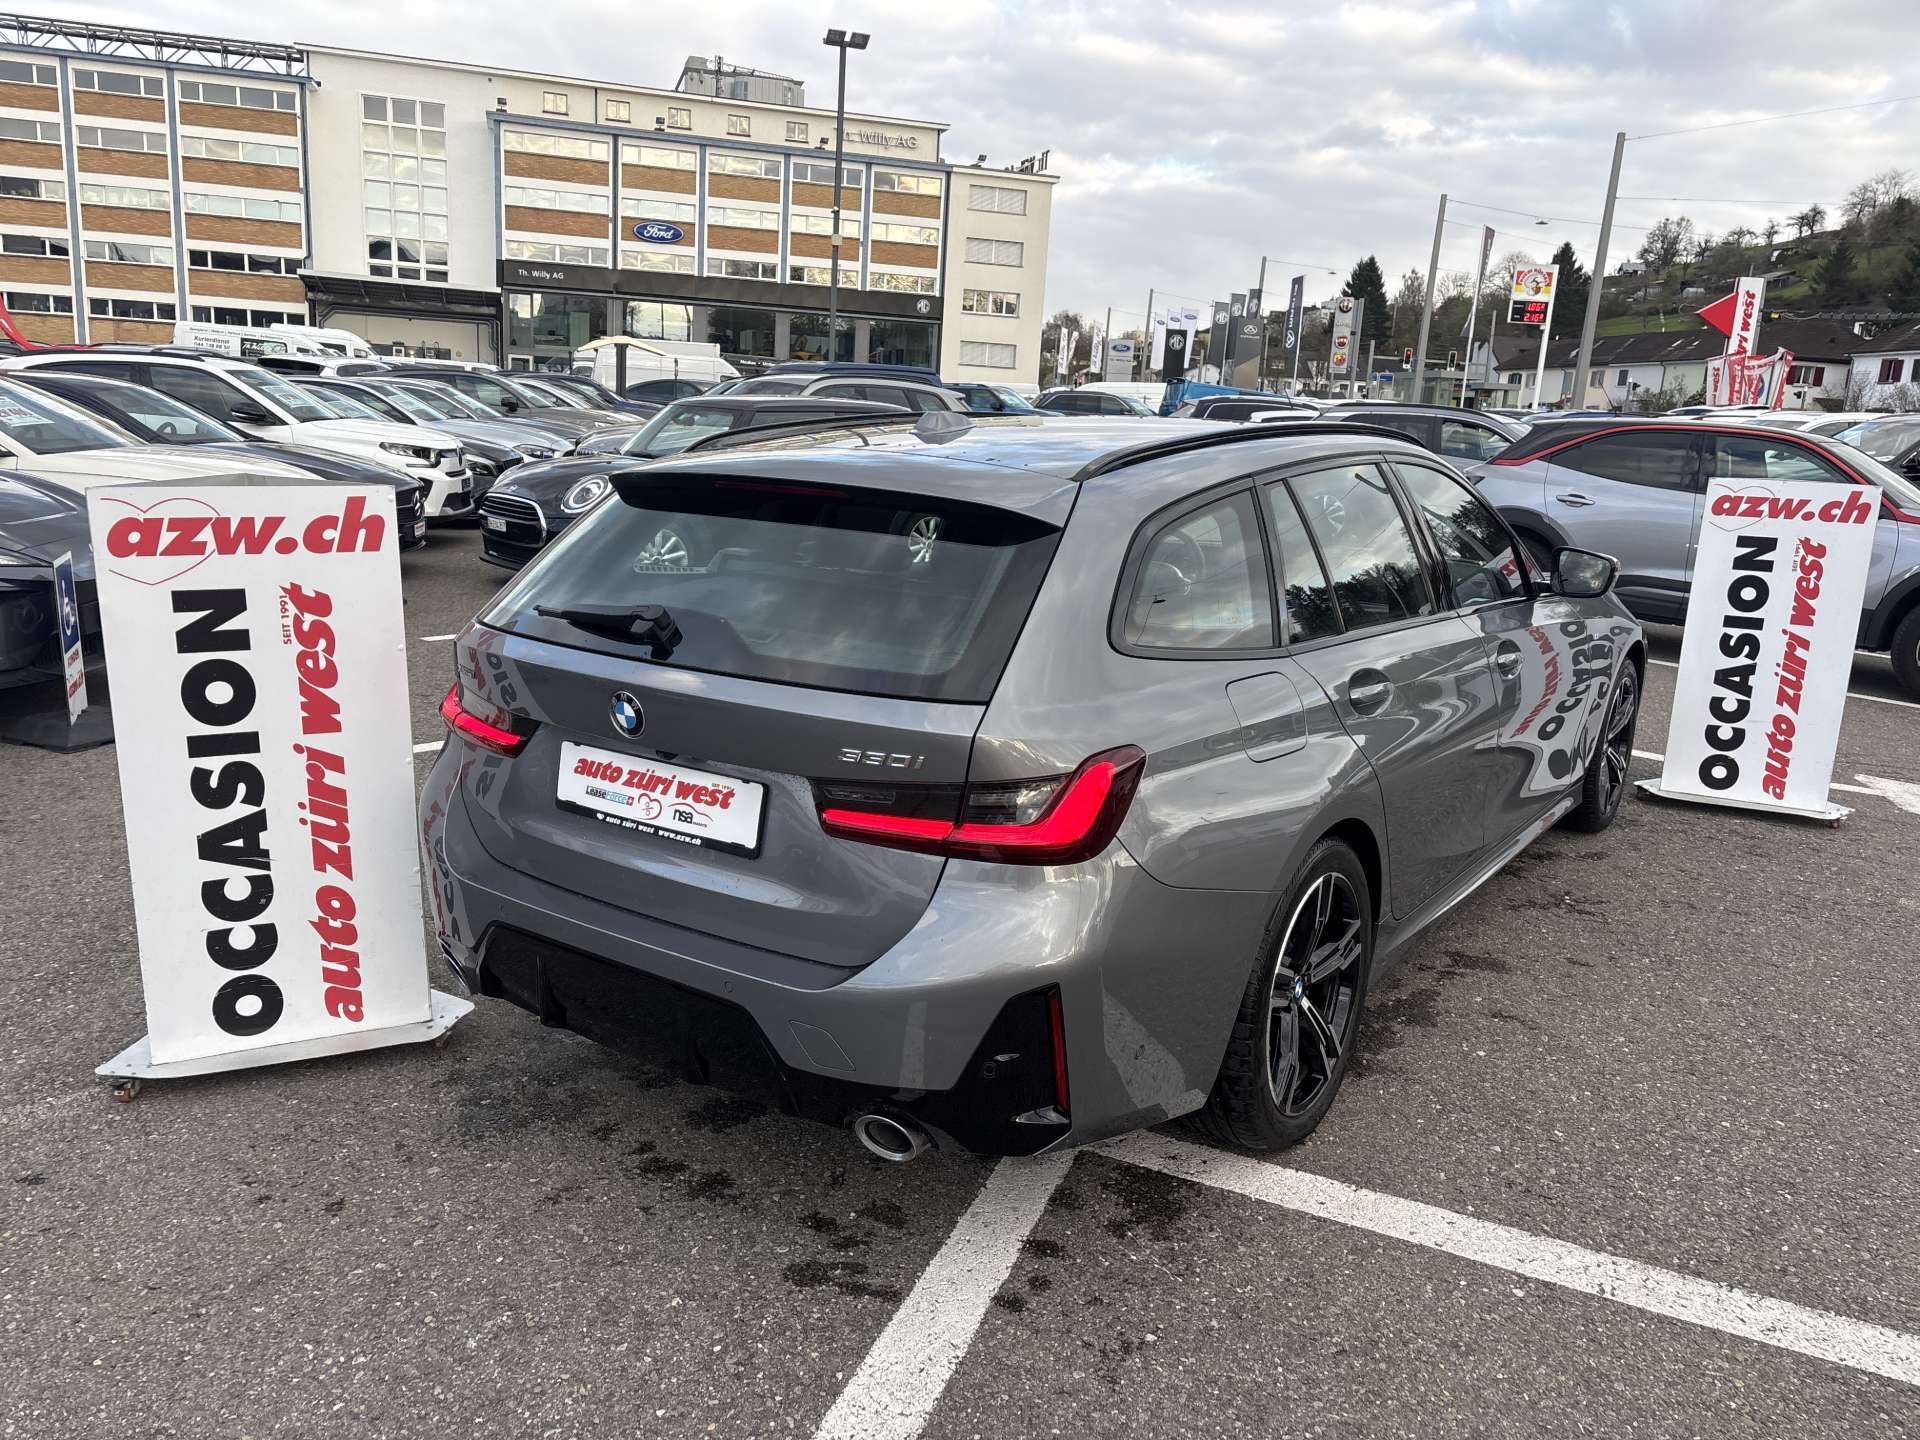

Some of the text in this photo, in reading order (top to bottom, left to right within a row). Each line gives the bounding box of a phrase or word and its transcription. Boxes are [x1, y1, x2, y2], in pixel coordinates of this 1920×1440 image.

[860, 129, 893, 149] Willy
[896, 135, 918, 149] AG
[643, 224, 674, 239] Ford
[518, 269, 530, 277] Th.
[532, 270, 551, 279] Willy
[1740, 290, 1756, 332] west
[1169, 335, 1184, 350] MG
[1711, 490, 1873, 525] azw.ch
[107, 496, 385, 558] azw.ch
[279, 595, 292, 645] SEIT 1991
[1698, 535, 1779, 791] OCCASION
[1762, 536, 1828, 801] auto züri west
[838, 748, 925, 769] 330i
[279, 582, 365, 1023] auto züri west
[574, 758, 735, 809] auto züri west
[171, 588, 285, 1037] OCCASION
[606, 816, 621, 825] auto
[638, 825, 655, 834] west
[673, 809, 693, 824] nsa
